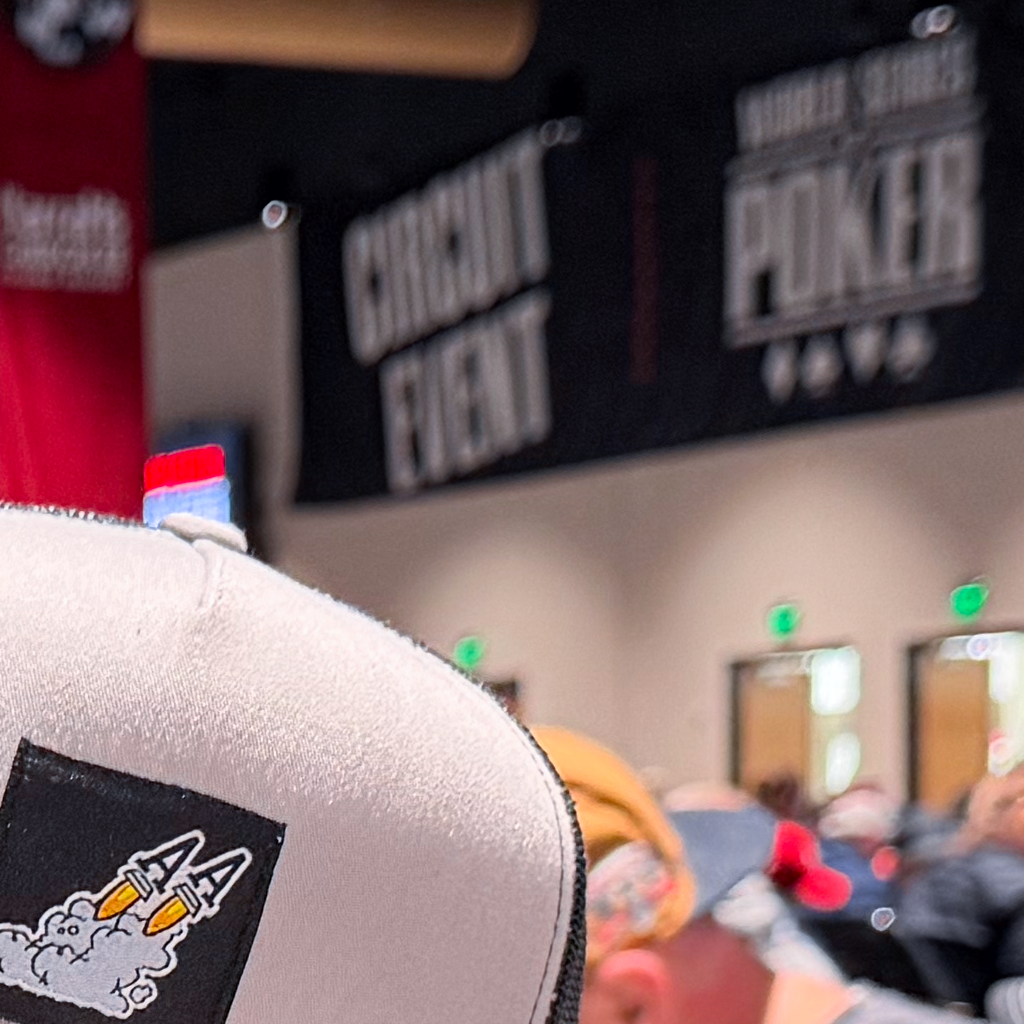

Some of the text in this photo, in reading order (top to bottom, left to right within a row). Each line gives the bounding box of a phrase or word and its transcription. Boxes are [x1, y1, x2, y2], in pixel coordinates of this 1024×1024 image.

[343, 126, 550, 366] CIRCUIT
[725, 134, 982, 330] POKER
[381, 288, 552, 493] EVENT
